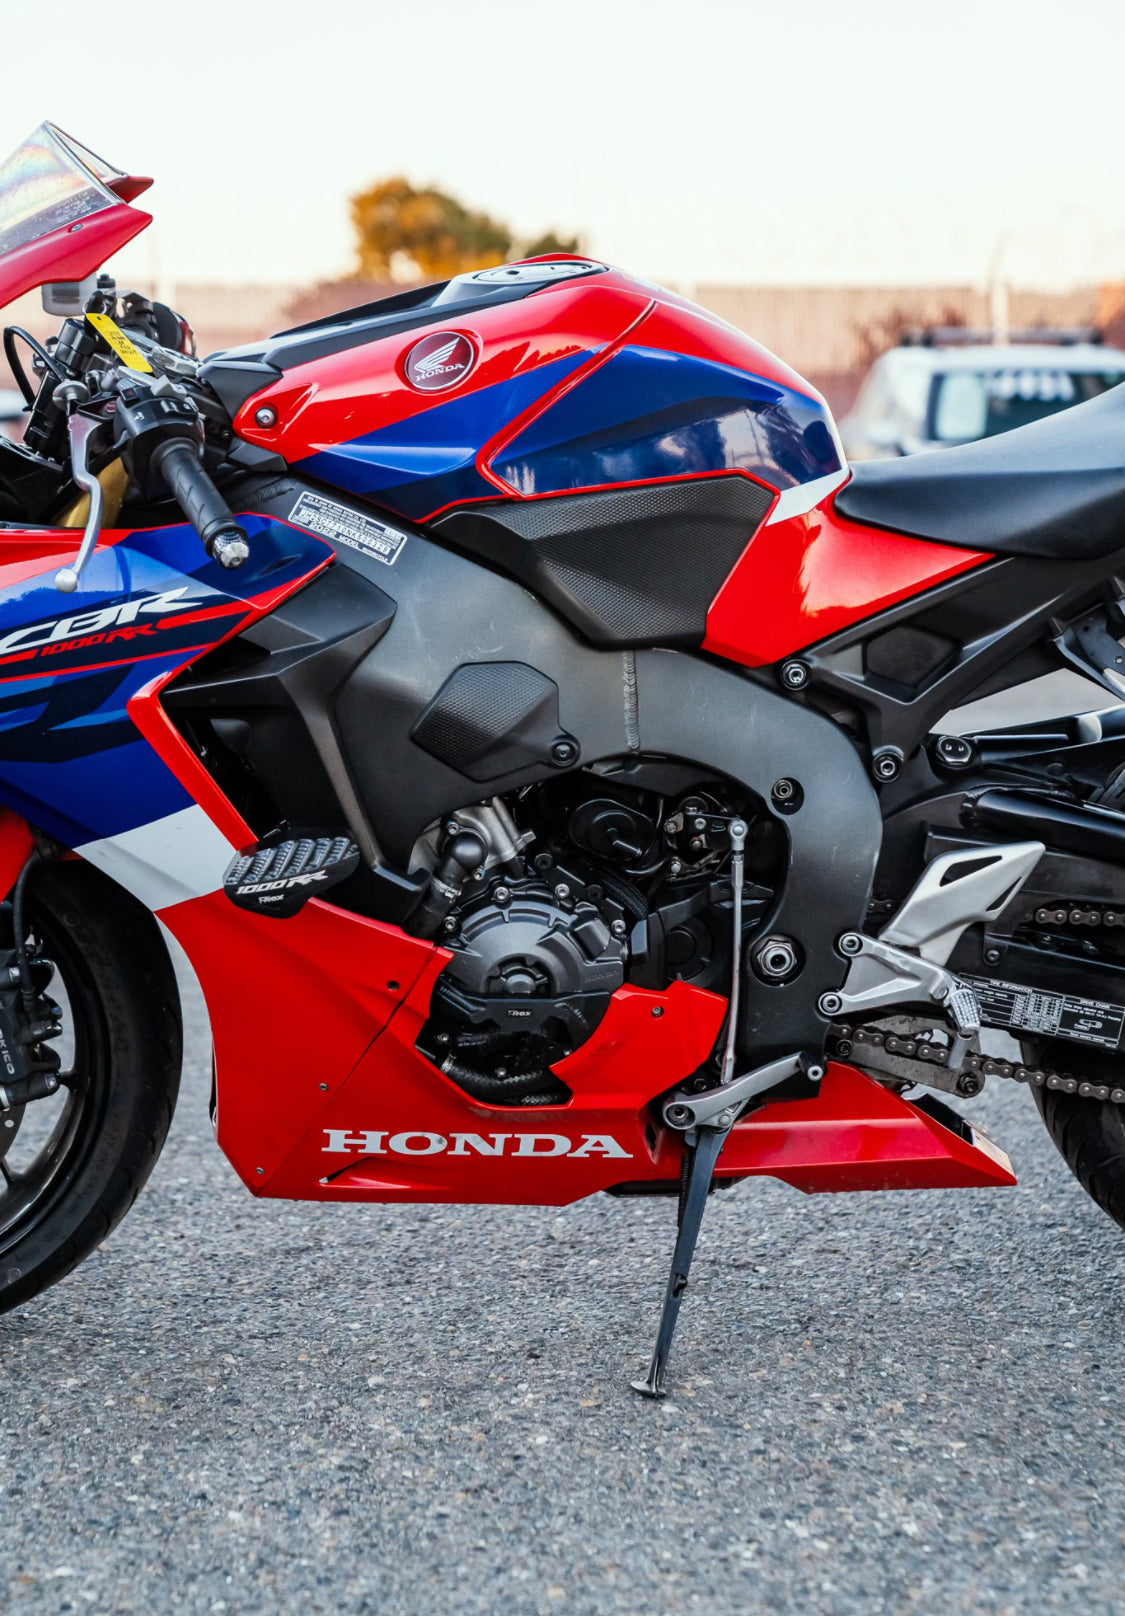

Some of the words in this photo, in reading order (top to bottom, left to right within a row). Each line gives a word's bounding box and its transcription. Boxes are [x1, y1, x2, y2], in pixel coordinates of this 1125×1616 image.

[415, 363, 465, 382] HONDA
[310, 522, 337, 538] 2022
[0, 586, 203, 654] CBR
[41, 623, 158, 657] 1000RR
[236, 869, 329, 895] 1000RR
[321, 1129, 634, 1159] HONDA
